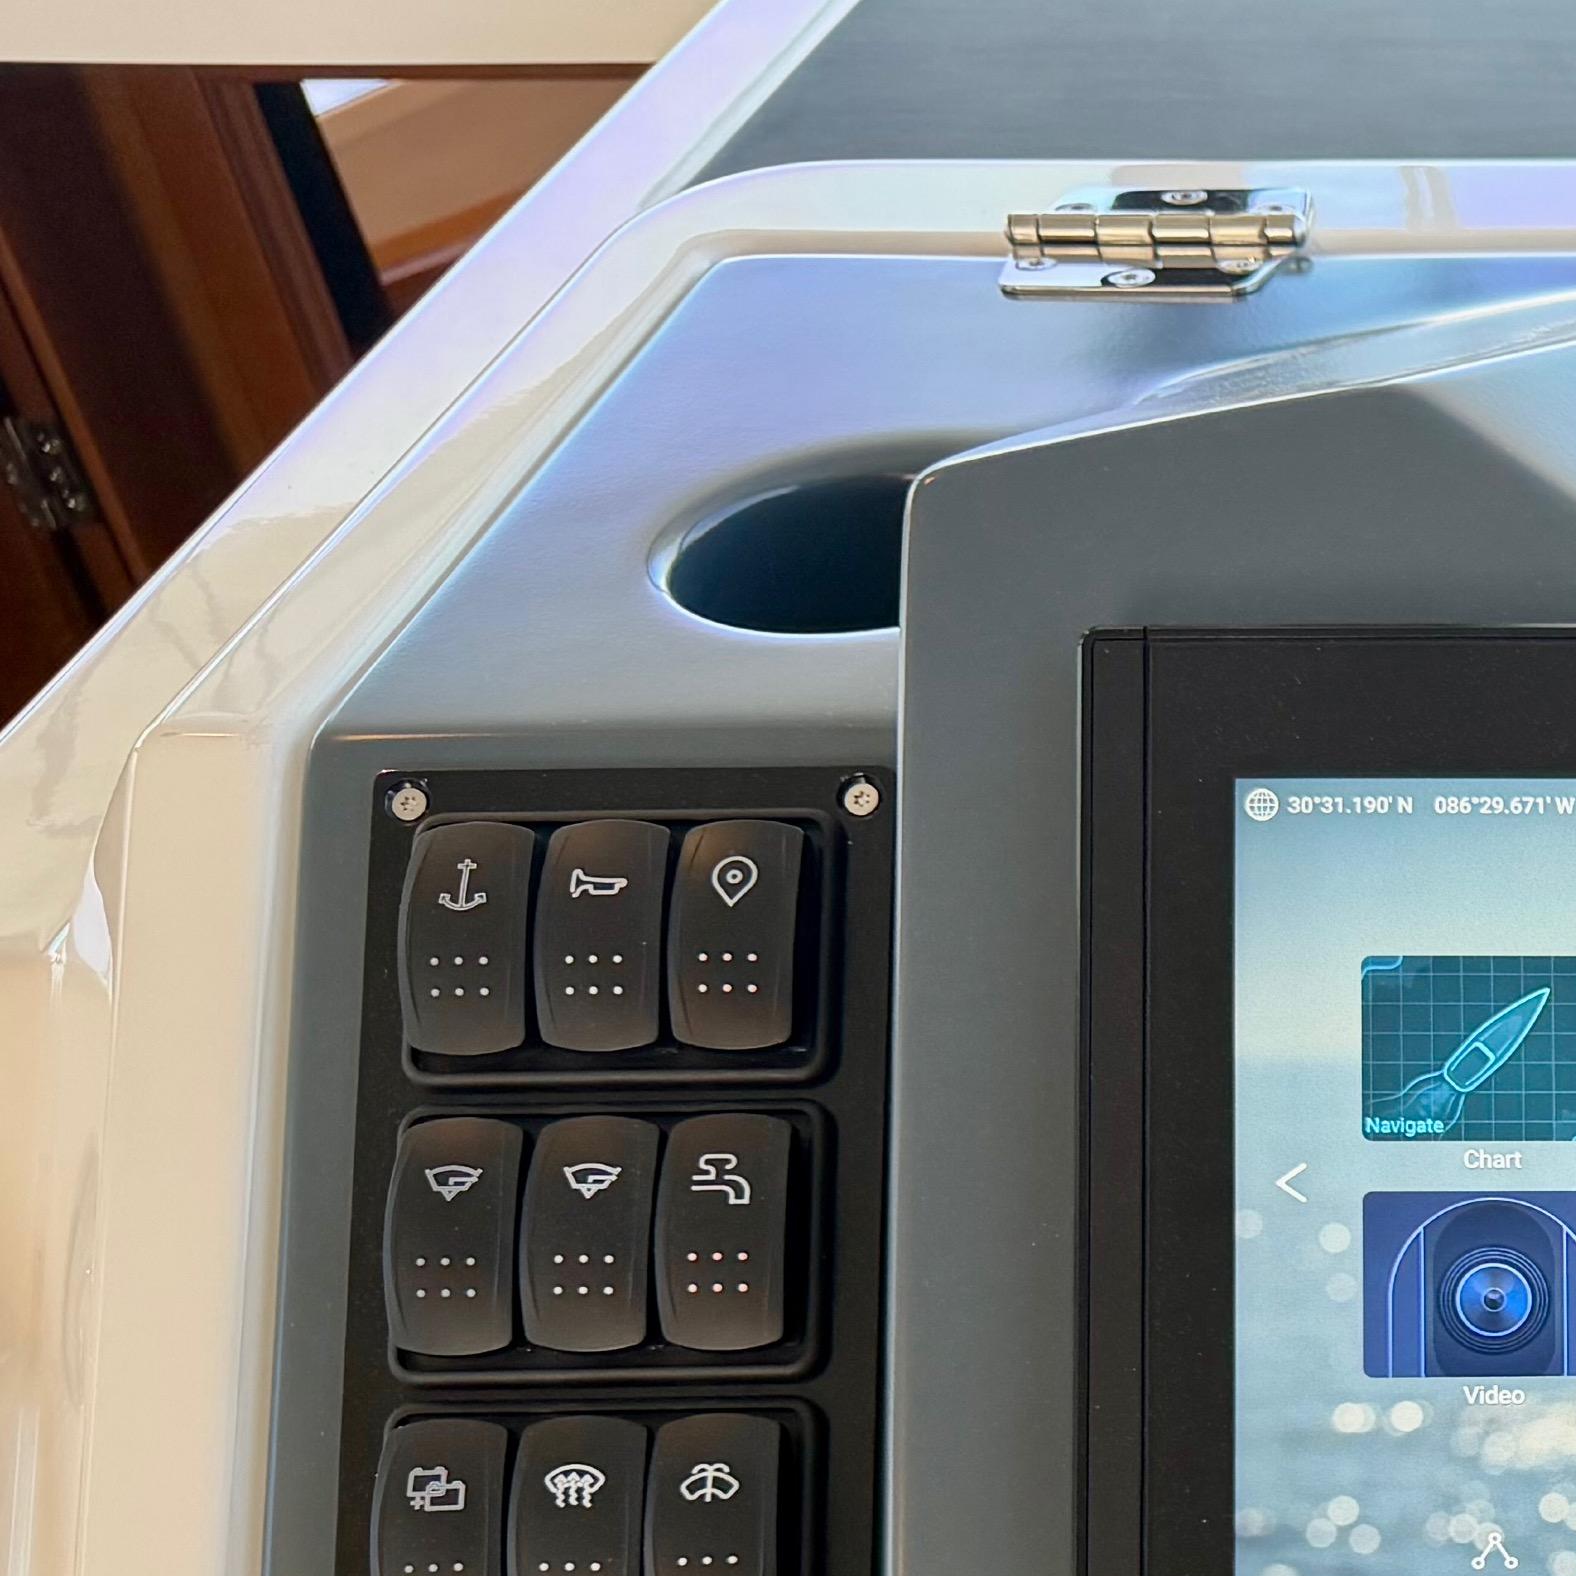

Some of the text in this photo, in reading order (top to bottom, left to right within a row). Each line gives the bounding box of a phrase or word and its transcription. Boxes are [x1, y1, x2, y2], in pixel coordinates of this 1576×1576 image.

[1398, 797, 1413, 814] N
[1555, 797, 1576, 815] W
[1365, 1117, 1445, 1137] Navigate
[1463, 1149, 1522, 1169] Chart
[1463, 1385, 1525, 1405] Video
